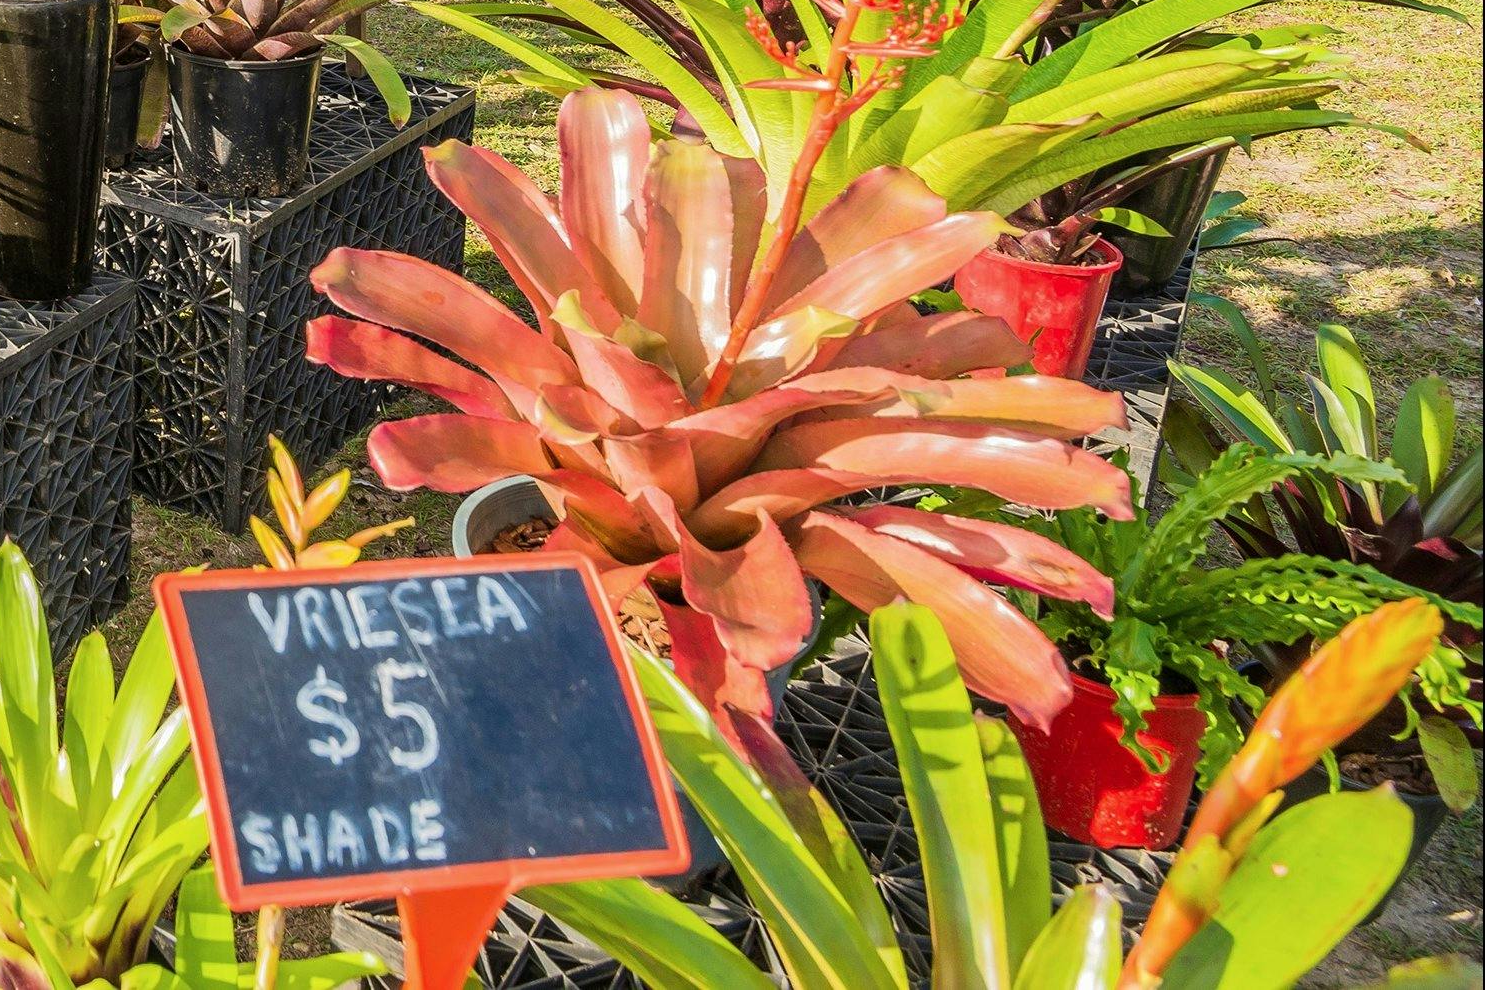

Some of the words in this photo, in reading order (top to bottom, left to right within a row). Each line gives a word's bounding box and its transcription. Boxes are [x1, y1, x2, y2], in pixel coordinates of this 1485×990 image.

[247, 575, 528, 654] VRIESEA
[295, 657, 440, 771] $5
[240, 798, 448, 874] SHADE
